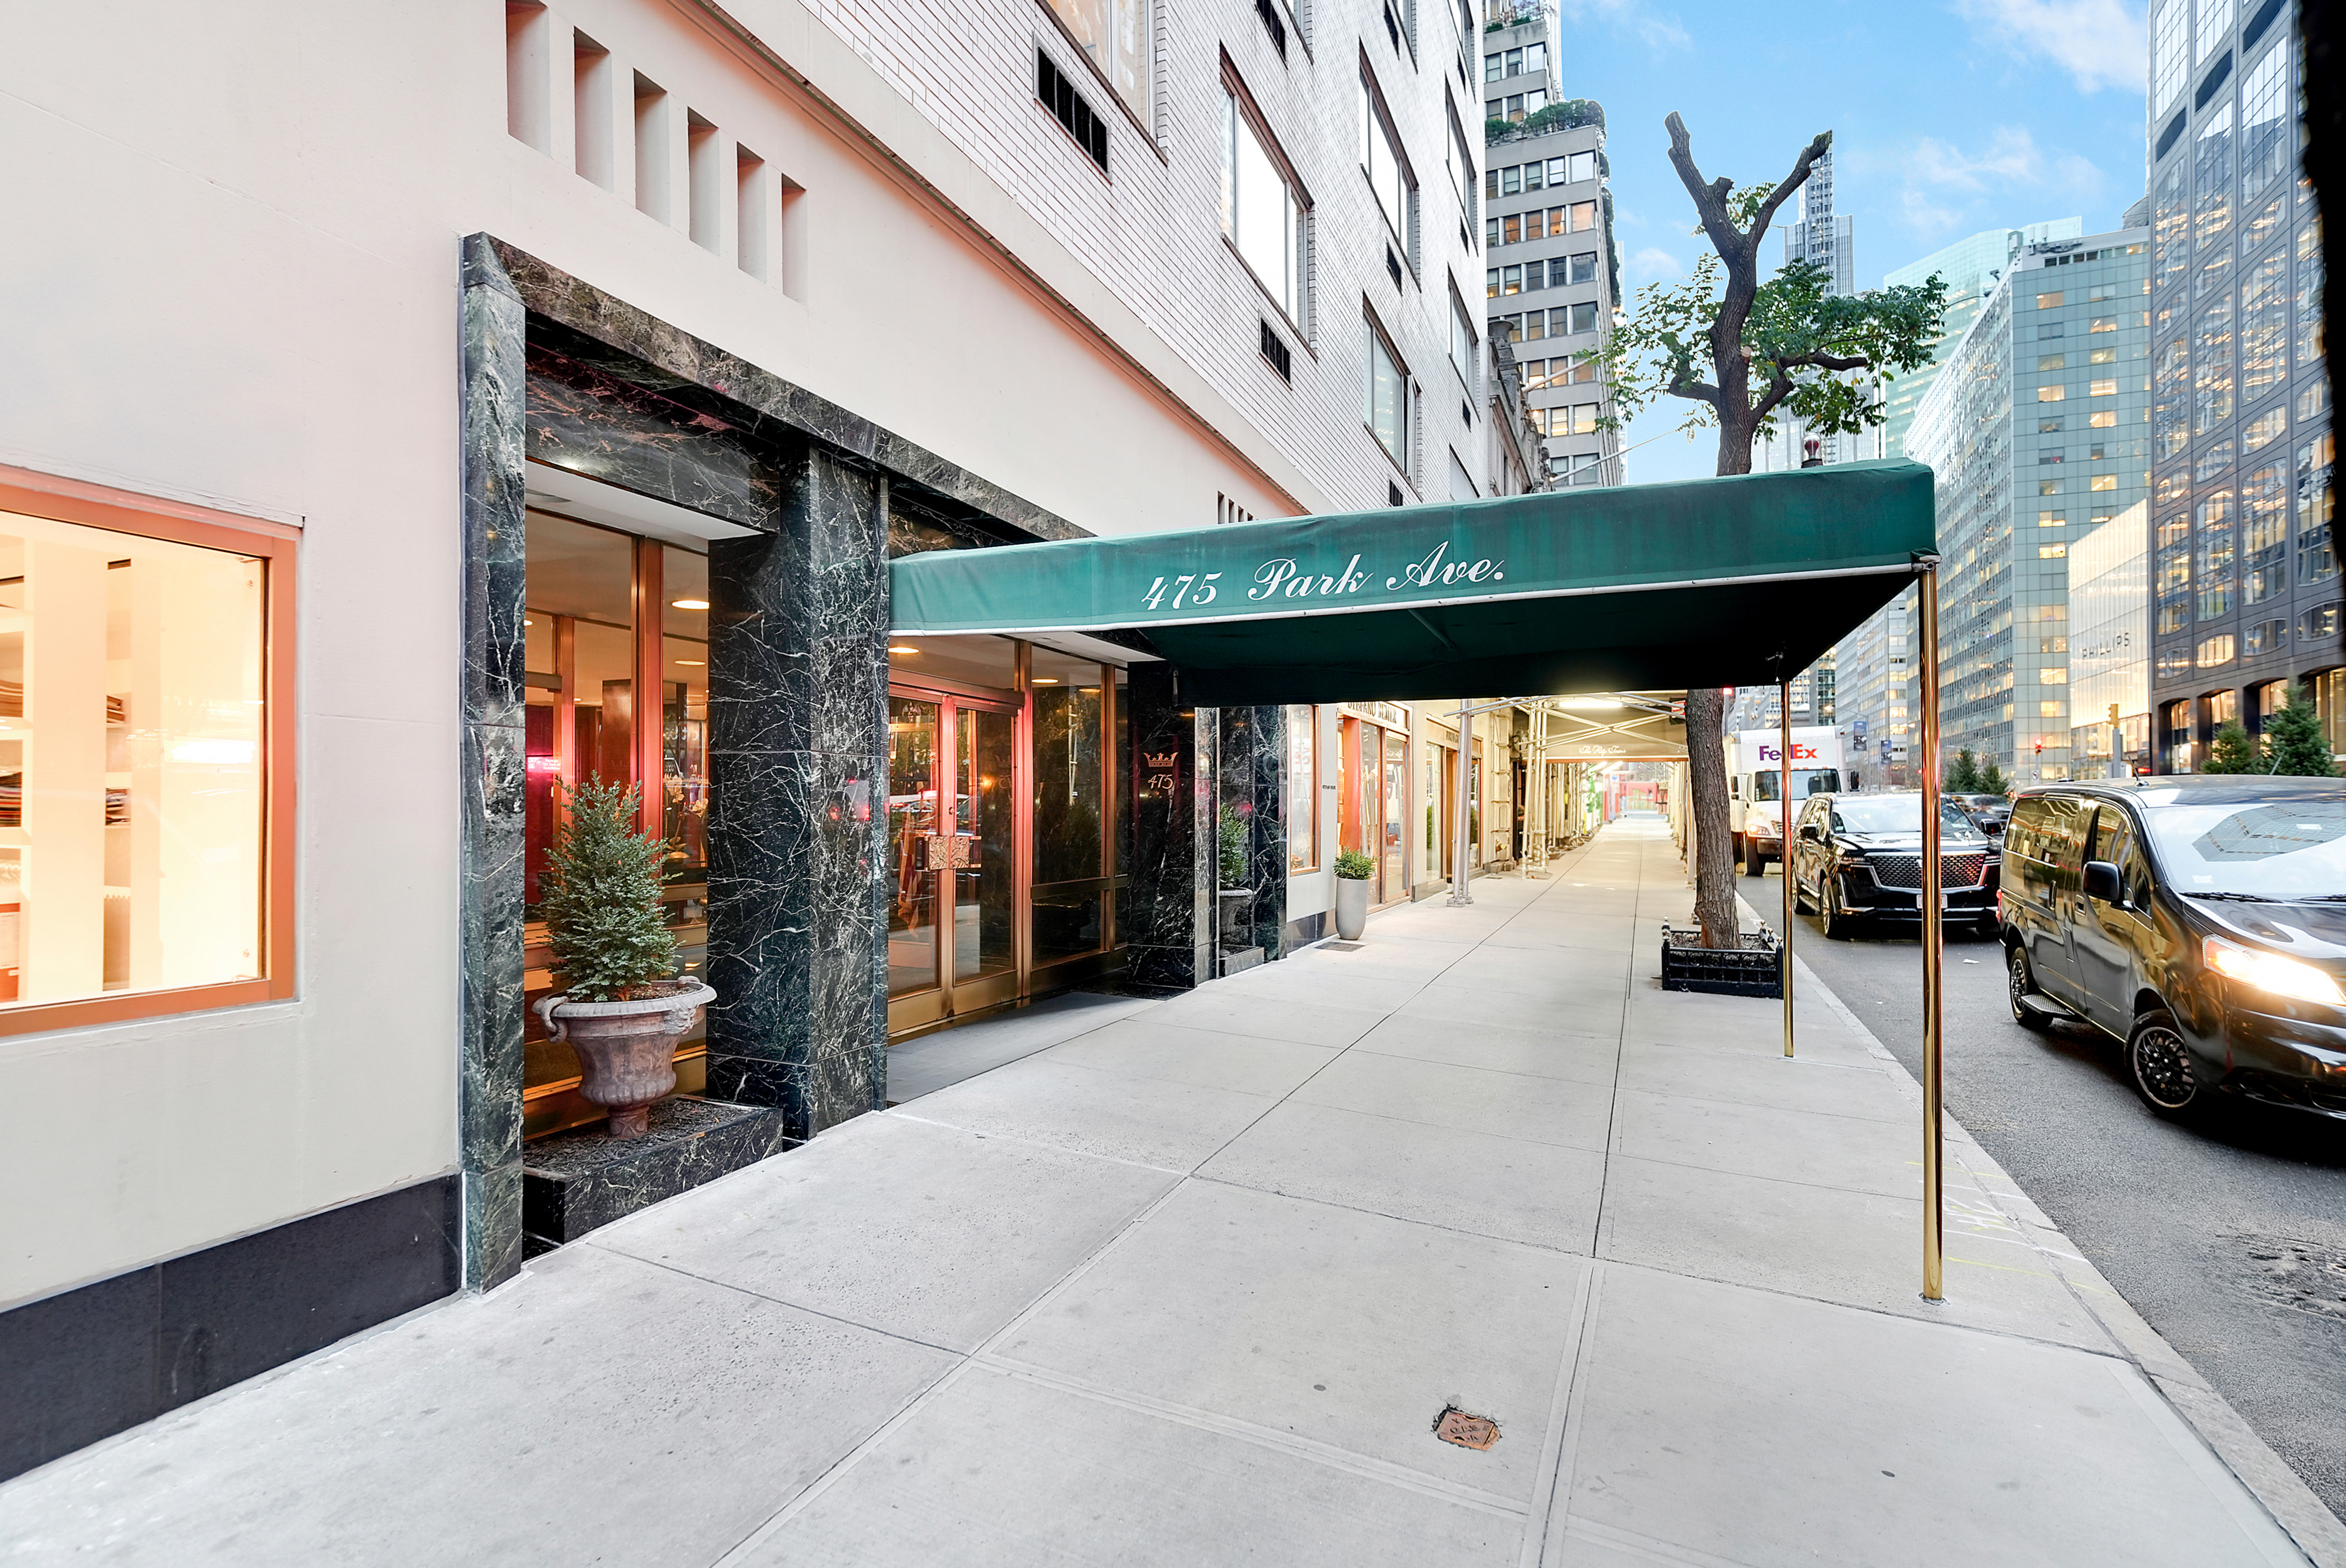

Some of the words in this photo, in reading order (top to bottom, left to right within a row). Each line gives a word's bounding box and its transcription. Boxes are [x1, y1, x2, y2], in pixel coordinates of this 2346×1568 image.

[1141, 572, 1222, 611] 475
[1247, 554, 1373, 601] Park
[1385, 540, 1504, 591] Ave.
[2083, 632, 2130, 660] PHILLIPS
[1148, 774, 1173, 789] 475
